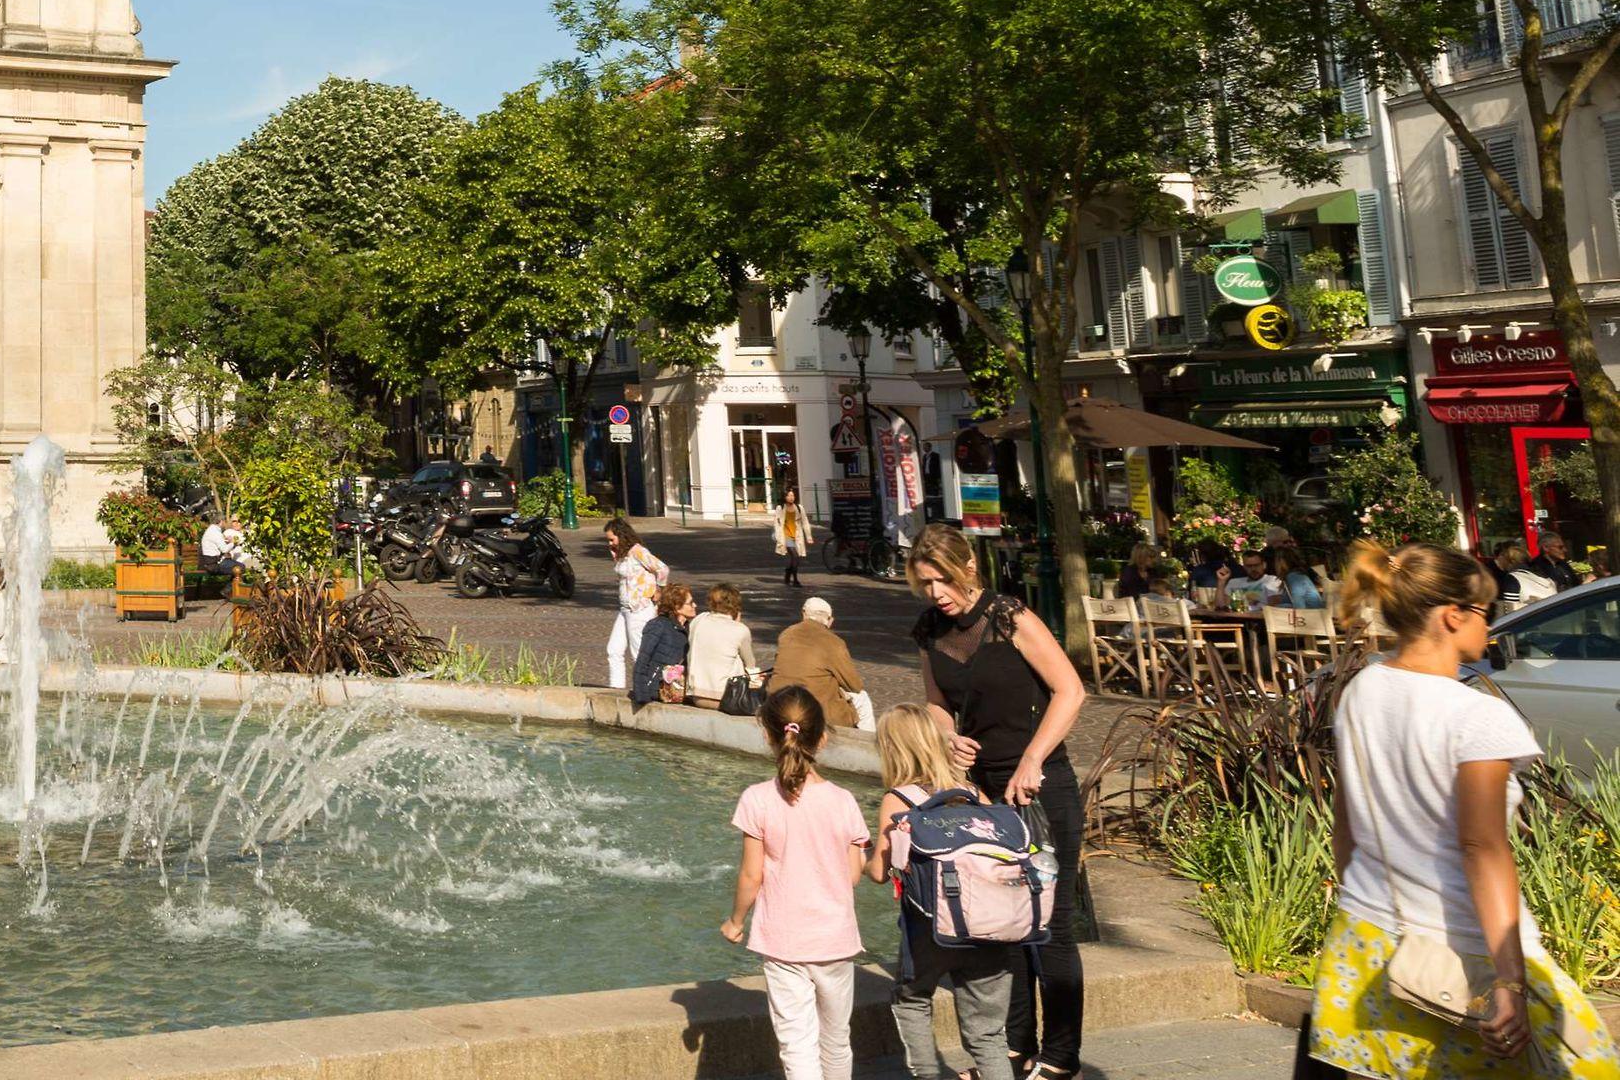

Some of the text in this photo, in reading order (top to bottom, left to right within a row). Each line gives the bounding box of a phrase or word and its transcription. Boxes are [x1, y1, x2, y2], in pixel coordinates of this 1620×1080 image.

[1221, 272, 1275, 288] Fleurs
[1451, 345, 1556, 364] Gilles Cresno
[1211, 365, 1377, 386] Les Fleurs de la Malmaison
[721, 383, 800, 395] des petits hauts
[1279, 412, 1288, 424] la
[1448, 403, 1540, 420] CHOCOLATIER
